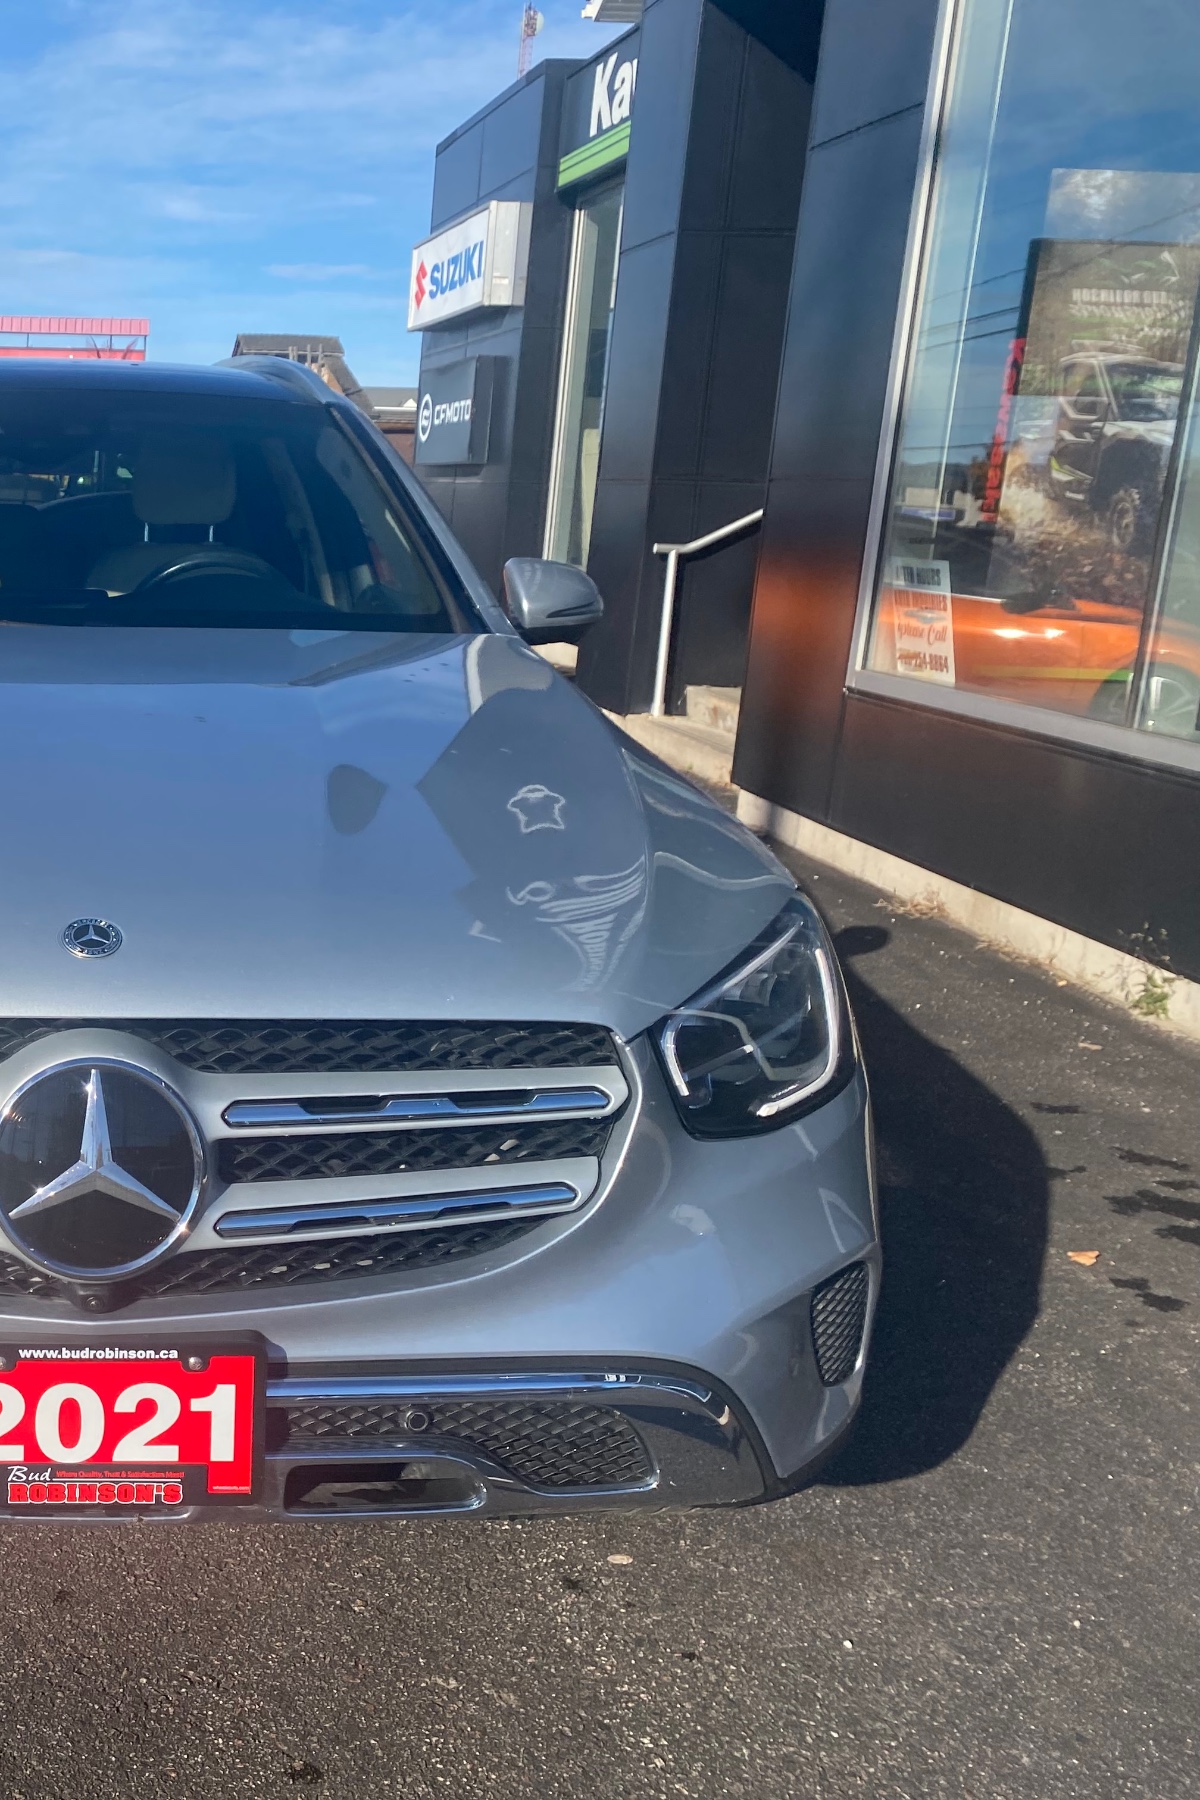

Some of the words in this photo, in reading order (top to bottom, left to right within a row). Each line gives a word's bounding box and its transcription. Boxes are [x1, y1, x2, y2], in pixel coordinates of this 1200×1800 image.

[428, 240, 485, 300] SUZUKI
[433, 398, 472, 426] CFMOTO
[18, 1346, 179, 1360] www.budrobinson.ca
[7, 1465, 52, 1481] Bud
[8, 1482, 184, 1505] ROBINSON'S
